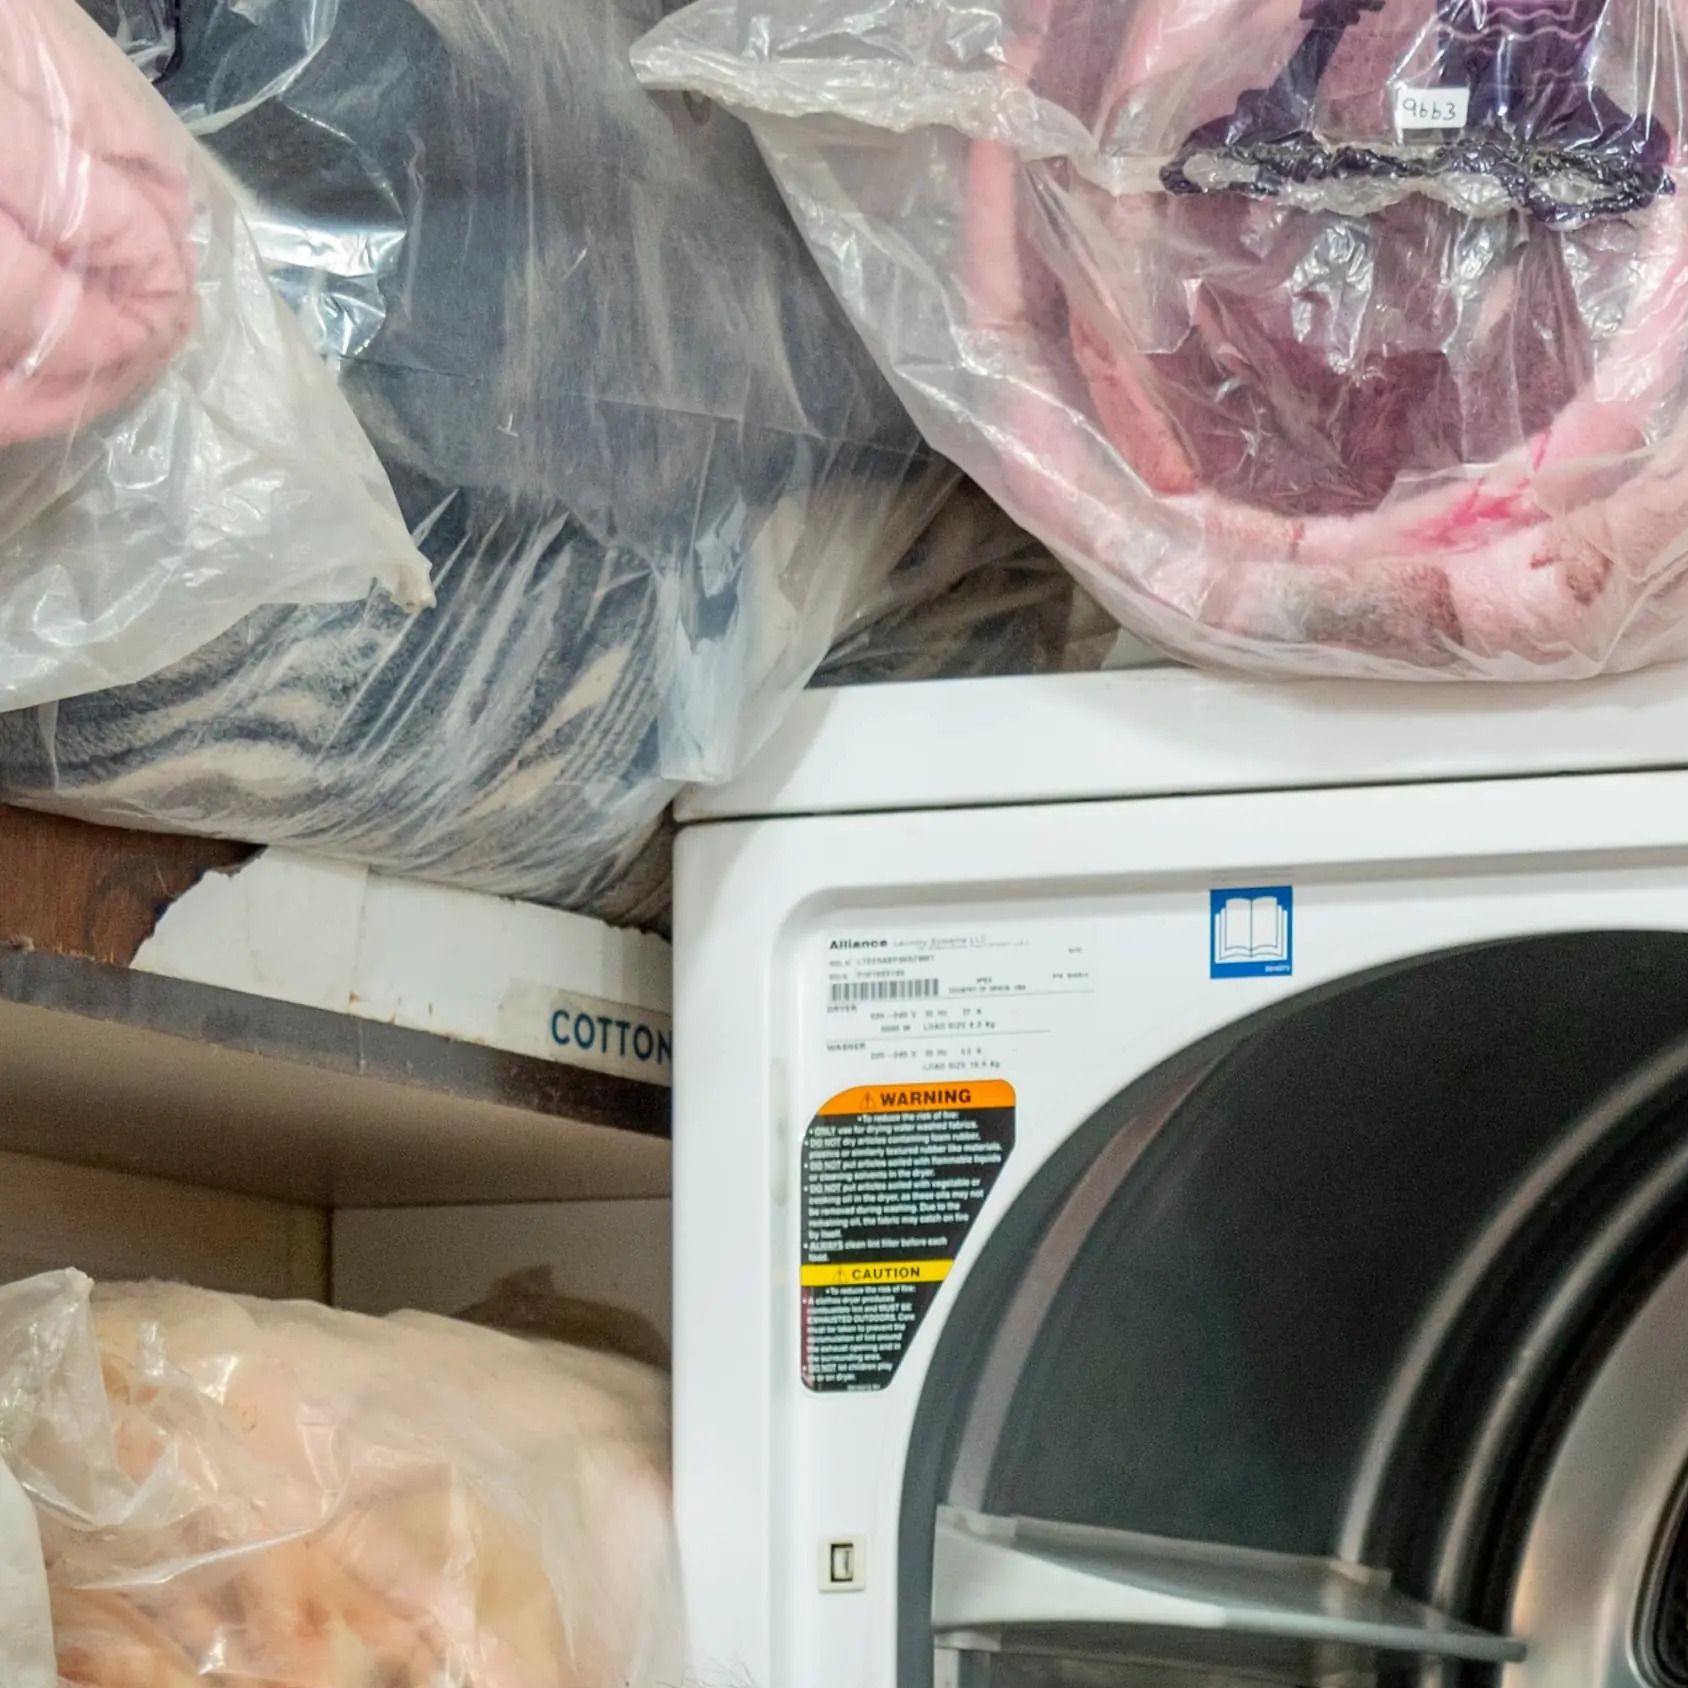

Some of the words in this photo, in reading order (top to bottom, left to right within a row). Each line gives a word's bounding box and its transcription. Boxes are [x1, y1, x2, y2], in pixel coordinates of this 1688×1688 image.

[829, 937, 888, 950] Alliance
[880, 1088, 972, 1107] WARNING
[851, 1266, 921, 1281] CAUTION
